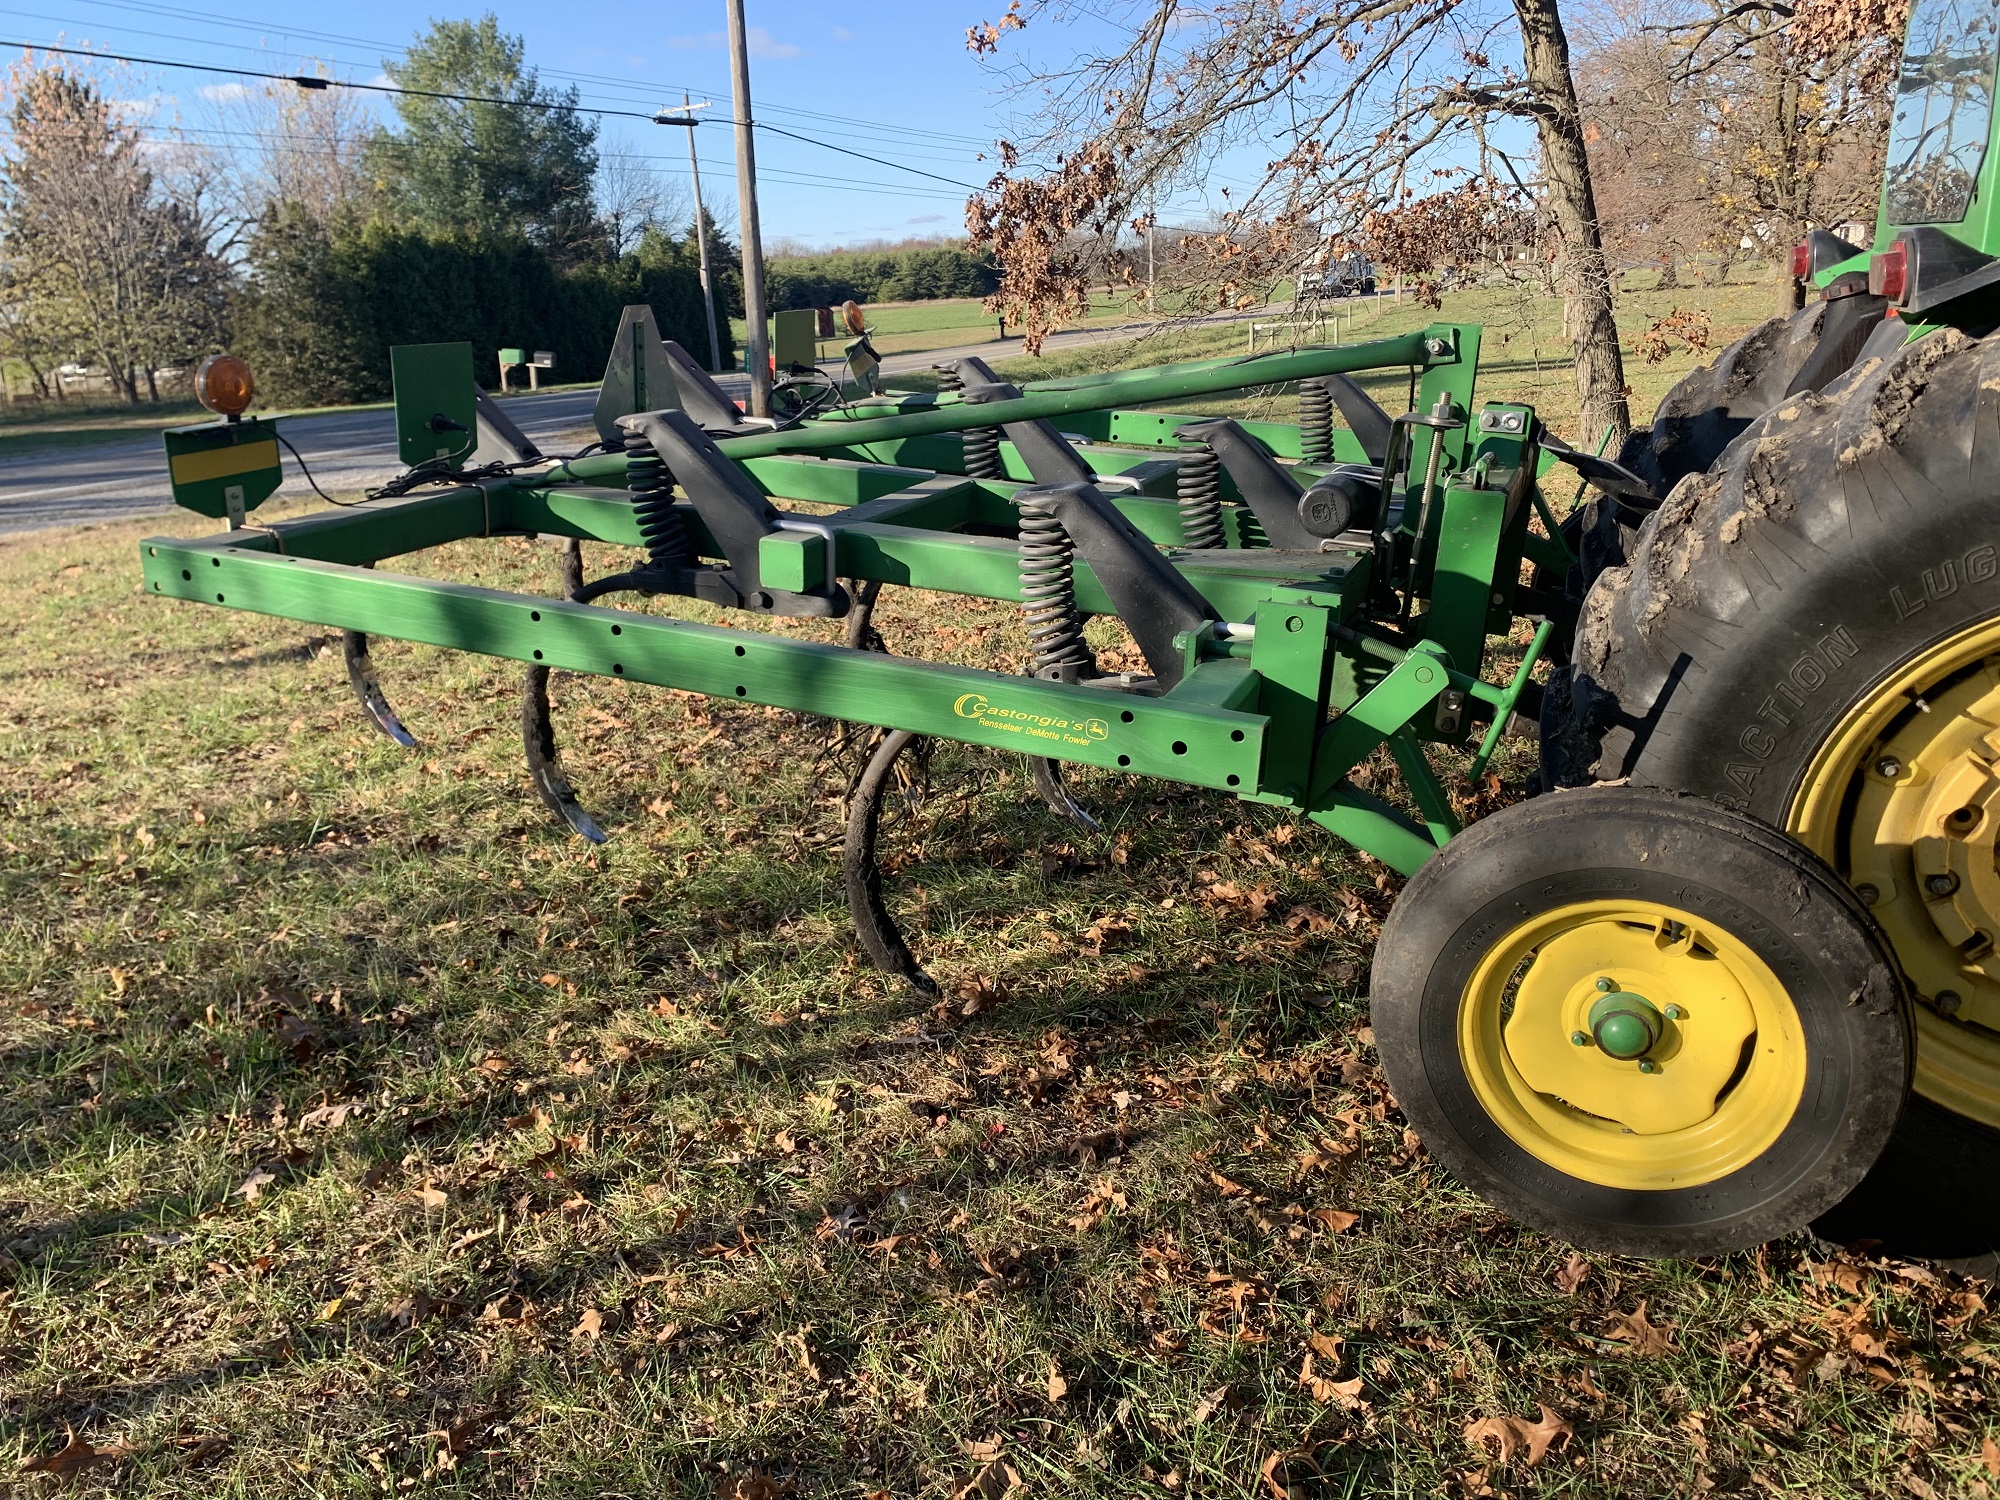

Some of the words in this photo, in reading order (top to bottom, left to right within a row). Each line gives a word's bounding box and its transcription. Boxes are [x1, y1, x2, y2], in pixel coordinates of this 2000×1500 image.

[1889, 545, 1999, 620] LUG
[953, 693, 1085, 732] Castongia's
[978, 717, 1023, 733] Rensselaer
[1025, 726, 1061, 742] DeMotte
[1062, 733, 1092, 747] Fowler
